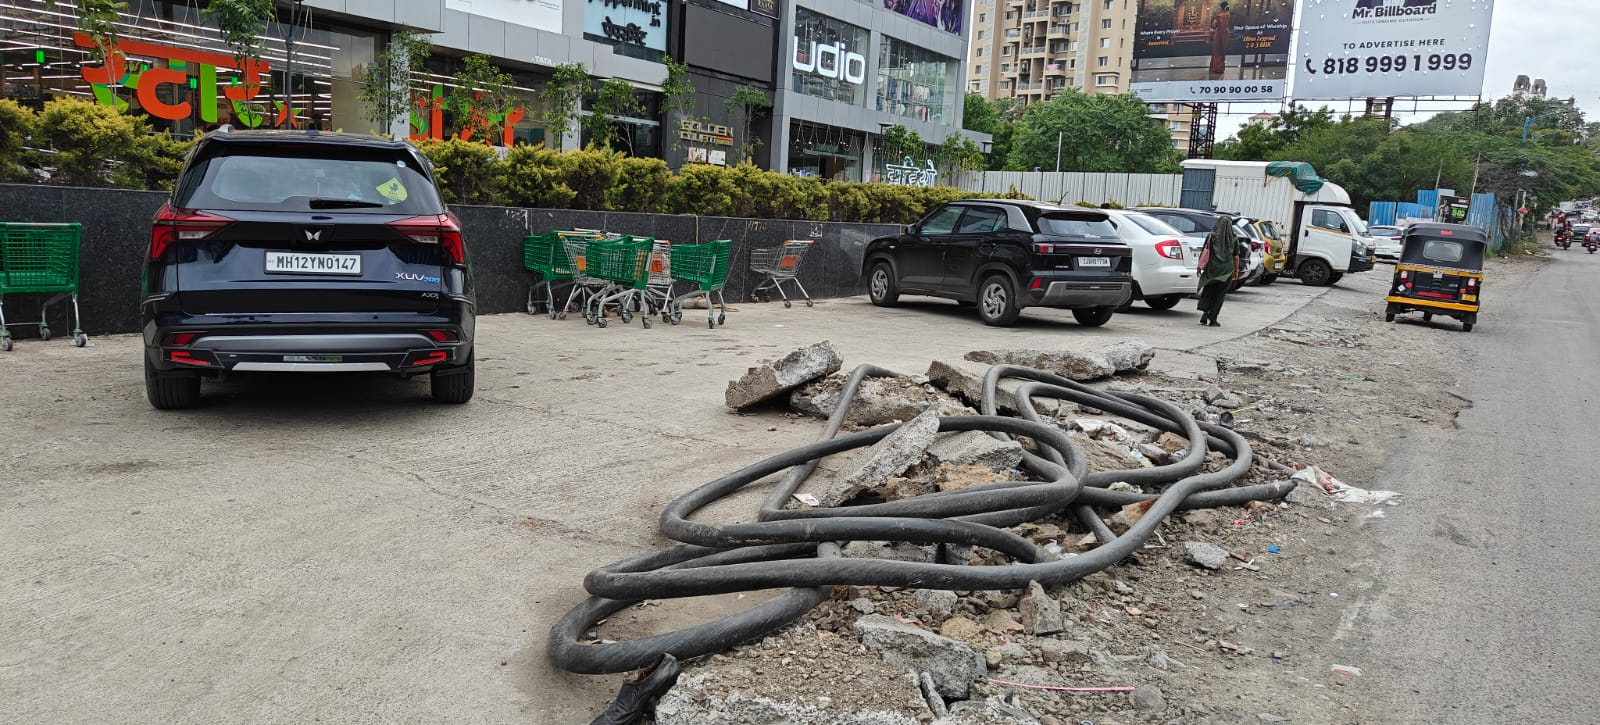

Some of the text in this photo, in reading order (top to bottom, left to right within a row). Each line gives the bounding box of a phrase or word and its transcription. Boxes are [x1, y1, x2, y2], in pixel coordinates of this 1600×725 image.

[1352, 4, 1437, 19] Mr. Billboard
[1359, 40, 1415, 49] ADVERTISE
[1418, 38, 1446, 47] HERE
[534, 55, 552, 65] TATA
[793, 36, 865, 85] udio
[1323, 57, 1359, 75] 818
[1365, 55, 1407, 73] 999
[1428, 53, 1472, 71] 999
[1200, 86, 1211, 94] 70
[1213, 86, 1226, 94] 90
[1229, 86, 1241, 94] 90
[1260, 85, 1273, 93] 58
[276, 255, 356, 270] MH12YN0147
